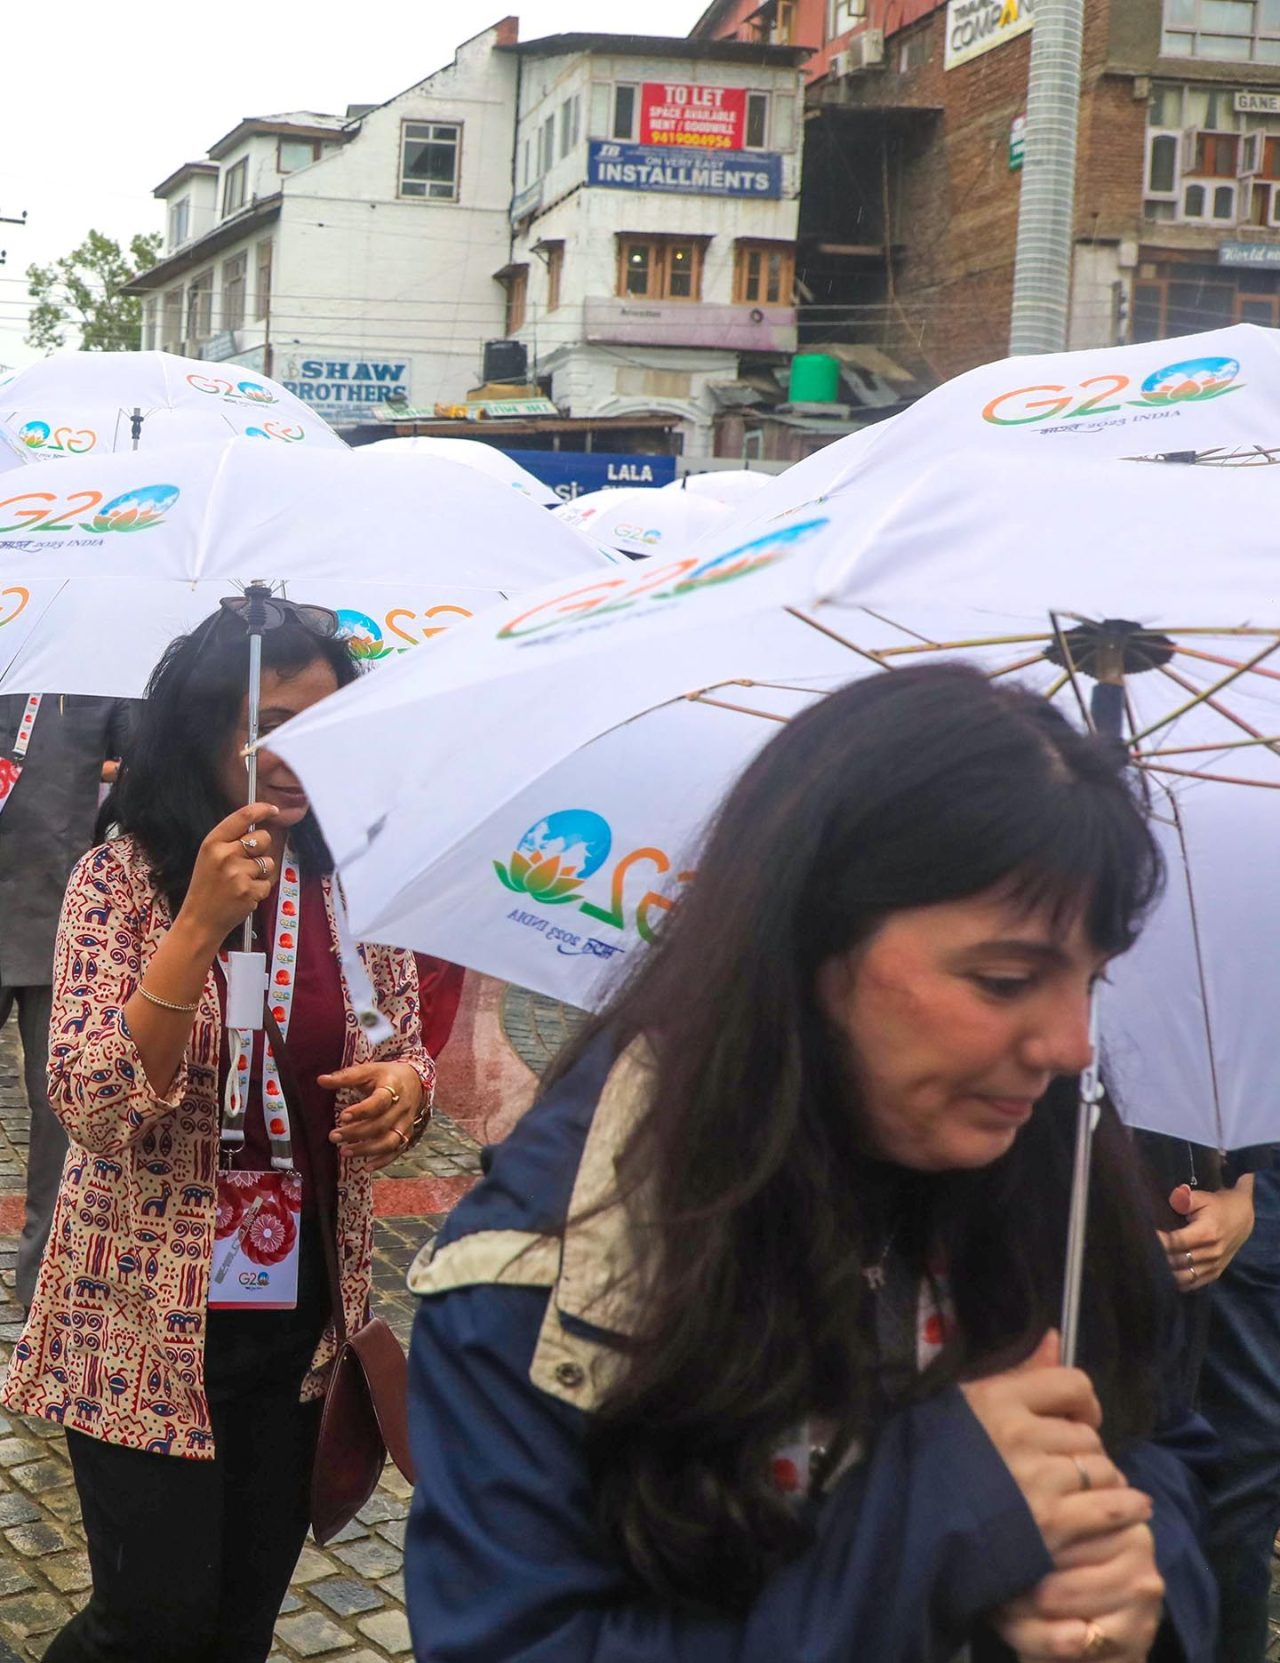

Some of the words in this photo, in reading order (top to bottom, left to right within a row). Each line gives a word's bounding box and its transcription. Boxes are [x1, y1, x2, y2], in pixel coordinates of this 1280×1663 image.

[665, 85, 687, 105] TO
[692, 87, 724, 107] LET
[598, 162, 770, 191] INSTALLMENTS
[302, 361, 406, 382] SHAW
[607, 463, 654, 482] LALA
